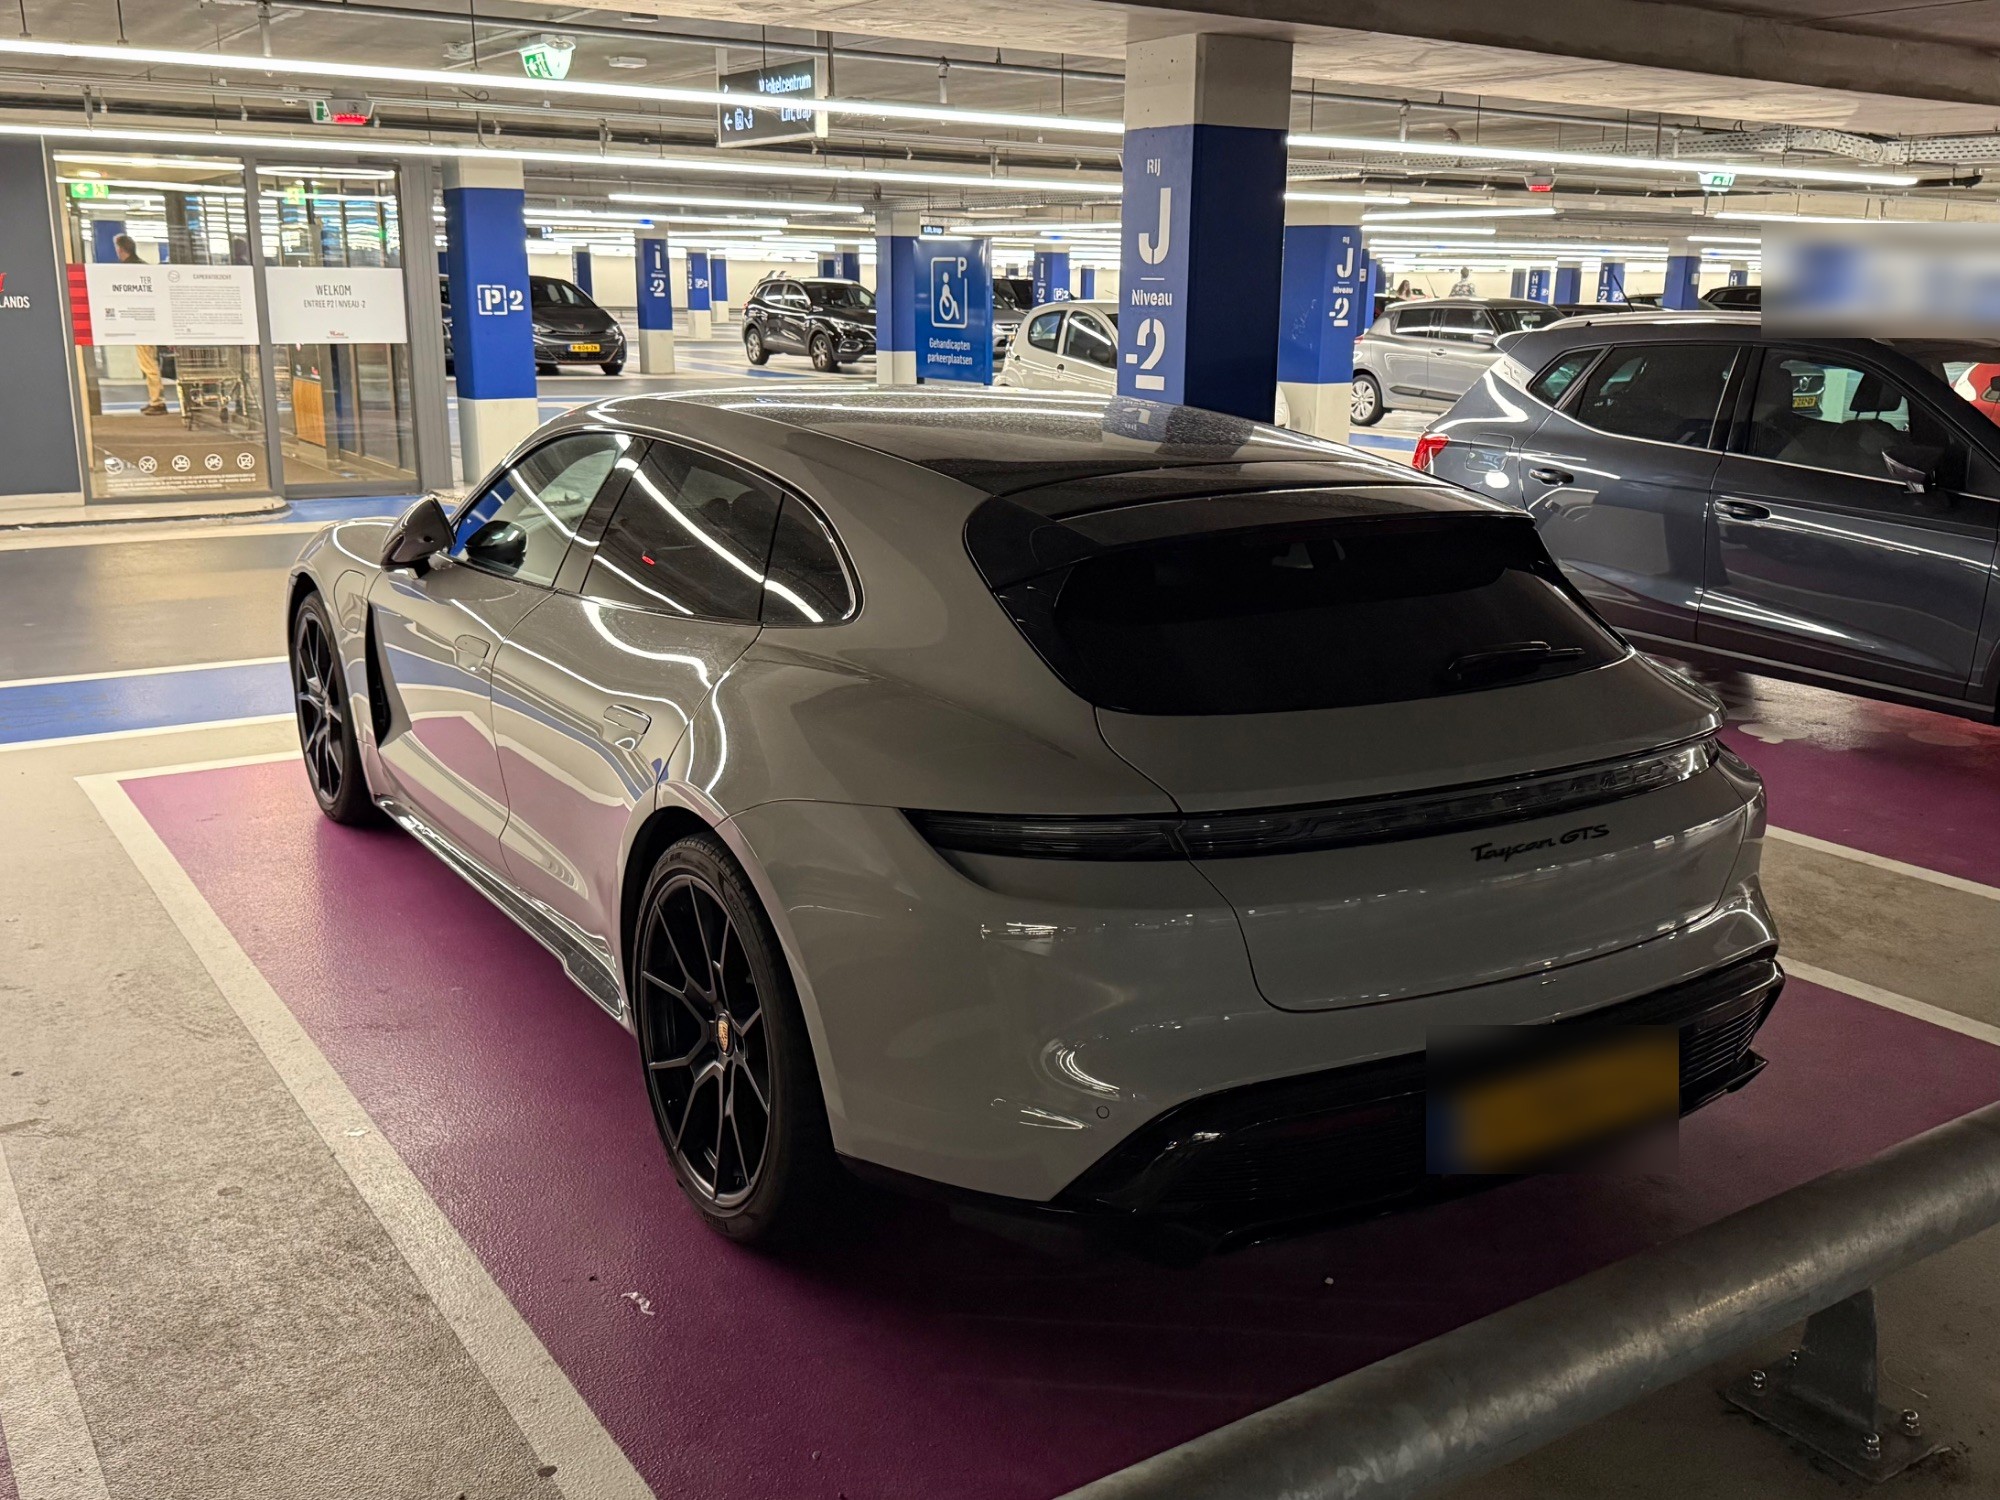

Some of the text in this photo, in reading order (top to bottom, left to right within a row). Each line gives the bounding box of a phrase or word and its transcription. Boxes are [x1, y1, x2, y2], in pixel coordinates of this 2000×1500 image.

[1138, 187, 1171, 265] J
[957, 256, 968, 278] P
[1336, 247, 1354, 278] J
[112, 284, 153, 293] INFORMATIE
[140, 276, 152, 284] TER
[315, 284, 352, 296] WELKOM
[1131, 288, 1172, 306] Niveau
[303, 299, 325, 308] ENTREE
[1328, 297, 1349, 327] -2
[929, 337, 971, 352] Gehandicapten
[927, 353, 973, 366] parkeerplaatsen
[1125, 318, 1166, 391] -2
[1470, 824, 1610, 862] Taycan GTS
